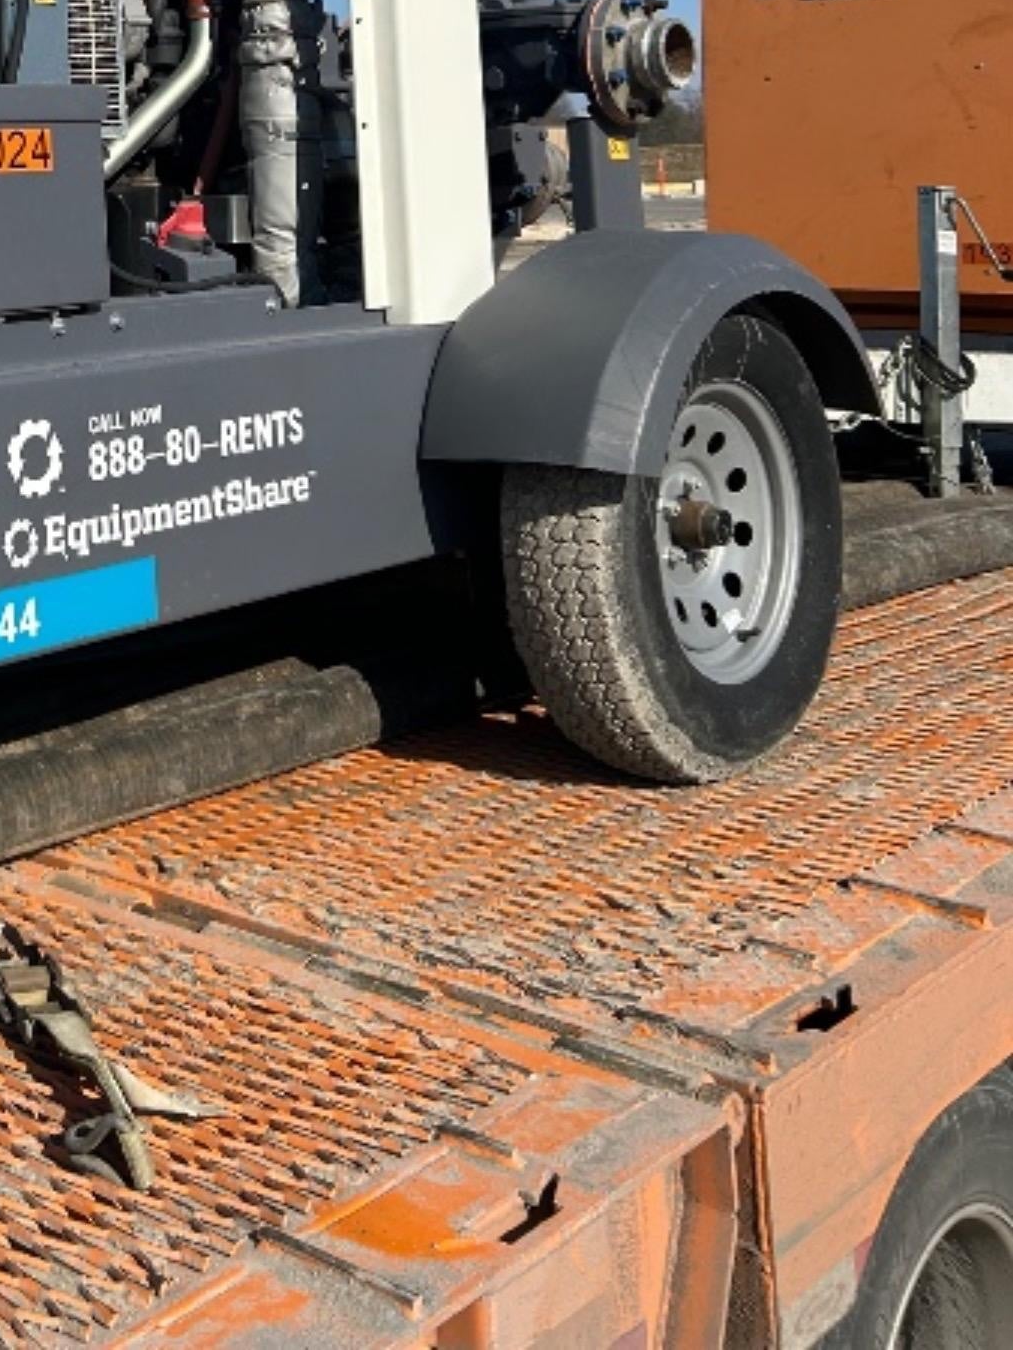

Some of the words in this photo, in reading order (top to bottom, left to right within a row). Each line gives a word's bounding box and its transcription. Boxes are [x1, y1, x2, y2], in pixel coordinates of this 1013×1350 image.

[88, 410, 125, 434] CALL
[130, 404, 162, 427] NOW
[88, 407, 304, 481] 888-80-RENTS
[44, 474, 310, 557] EquipmentShare
